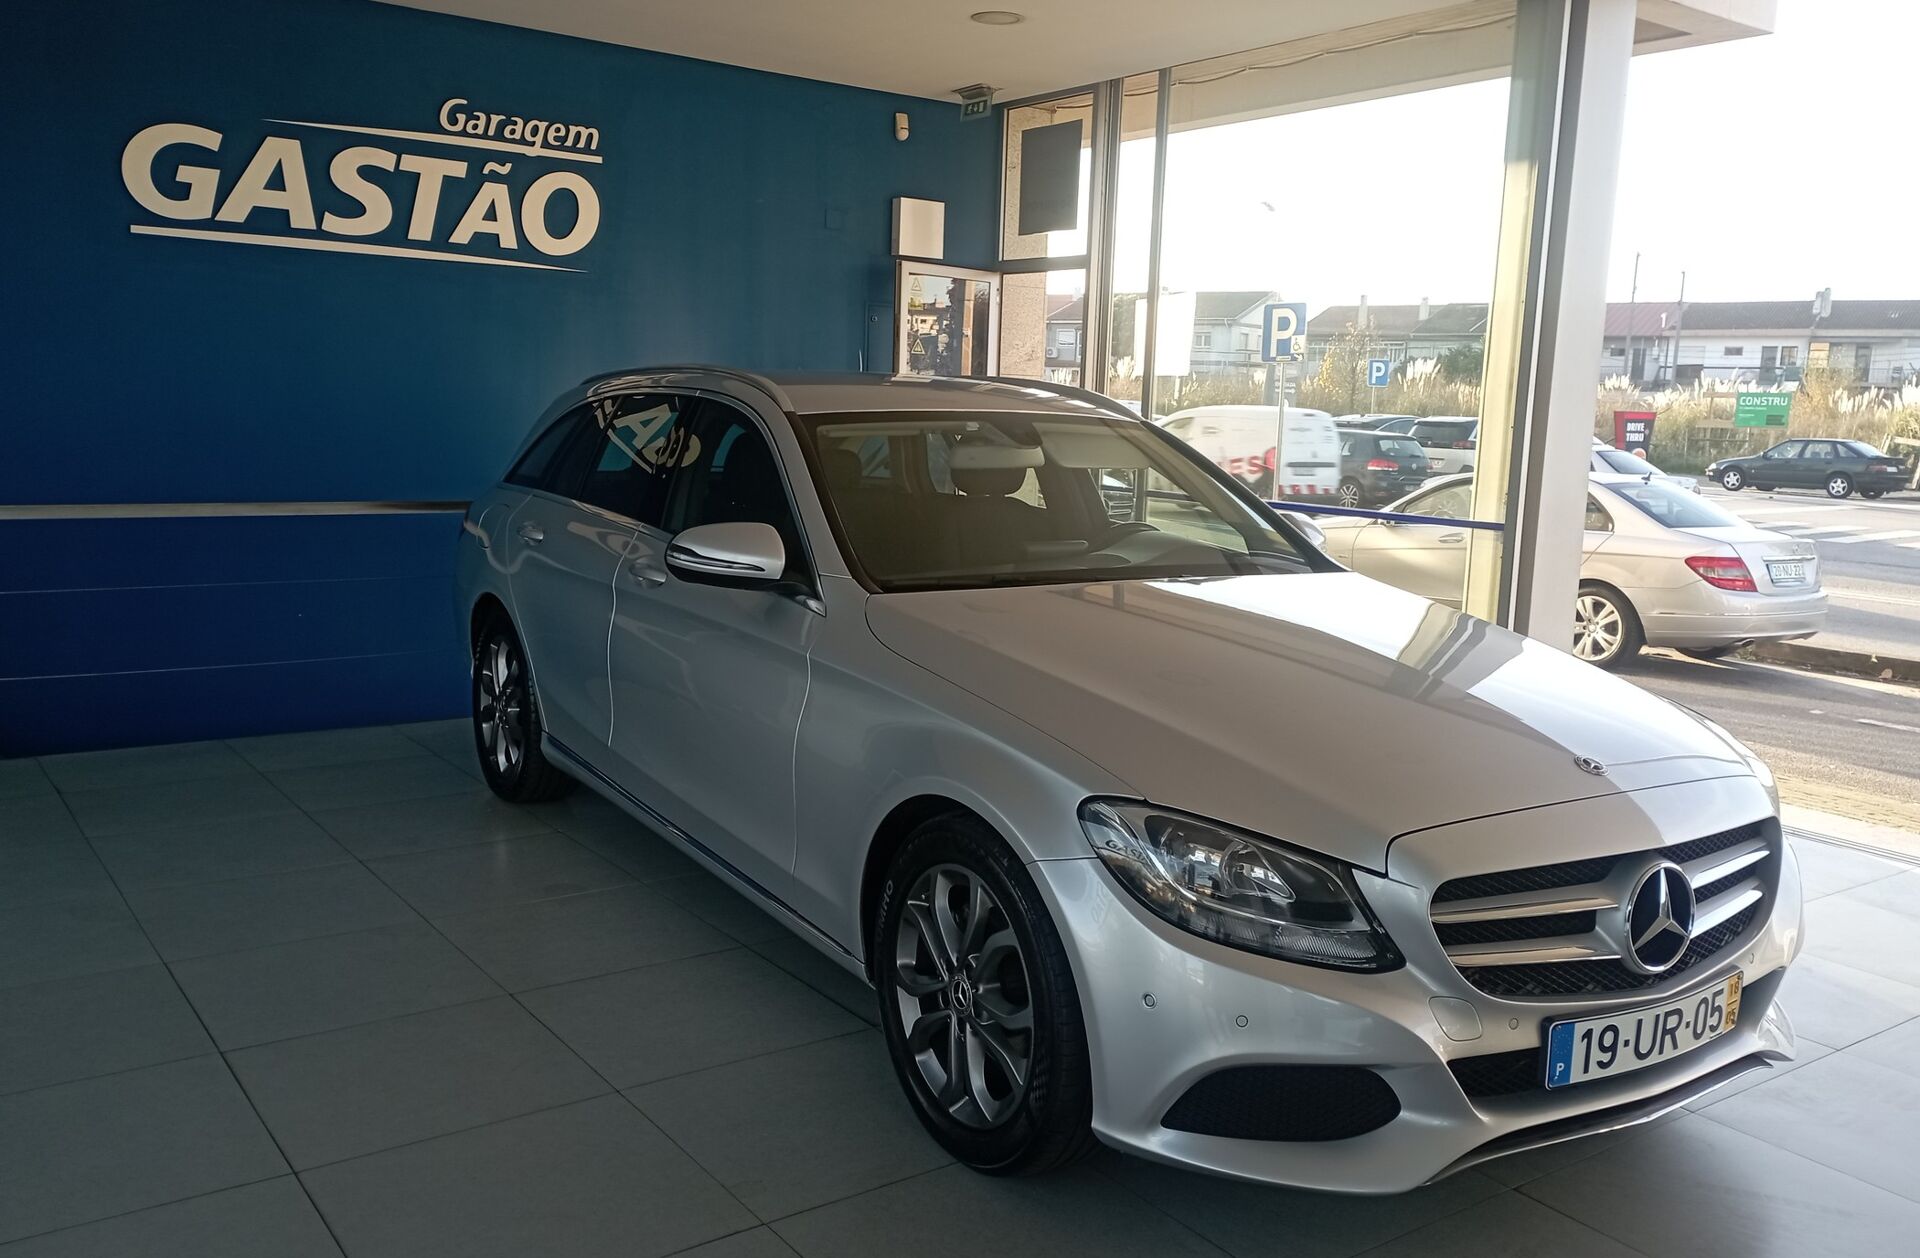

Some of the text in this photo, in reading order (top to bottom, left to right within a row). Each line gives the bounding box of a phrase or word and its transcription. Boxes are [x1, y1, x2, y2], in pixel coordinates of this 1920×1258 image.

[439, 98, 600, 156] Garagem
[121, 123, 600, 256] GASTÃO
[1270, 307, 1297, 358] P
[1371, 362, 1386, 384] P
[1740, 396, 1788, 406] CONSTRU
[1625, 432, 1645, 442] THRU
[1626, 422, 1645, 431] DRIVE
[1581, 988, 1724, 1075] 19-UR-05
[1555, 1062, 1565, 1076] P
